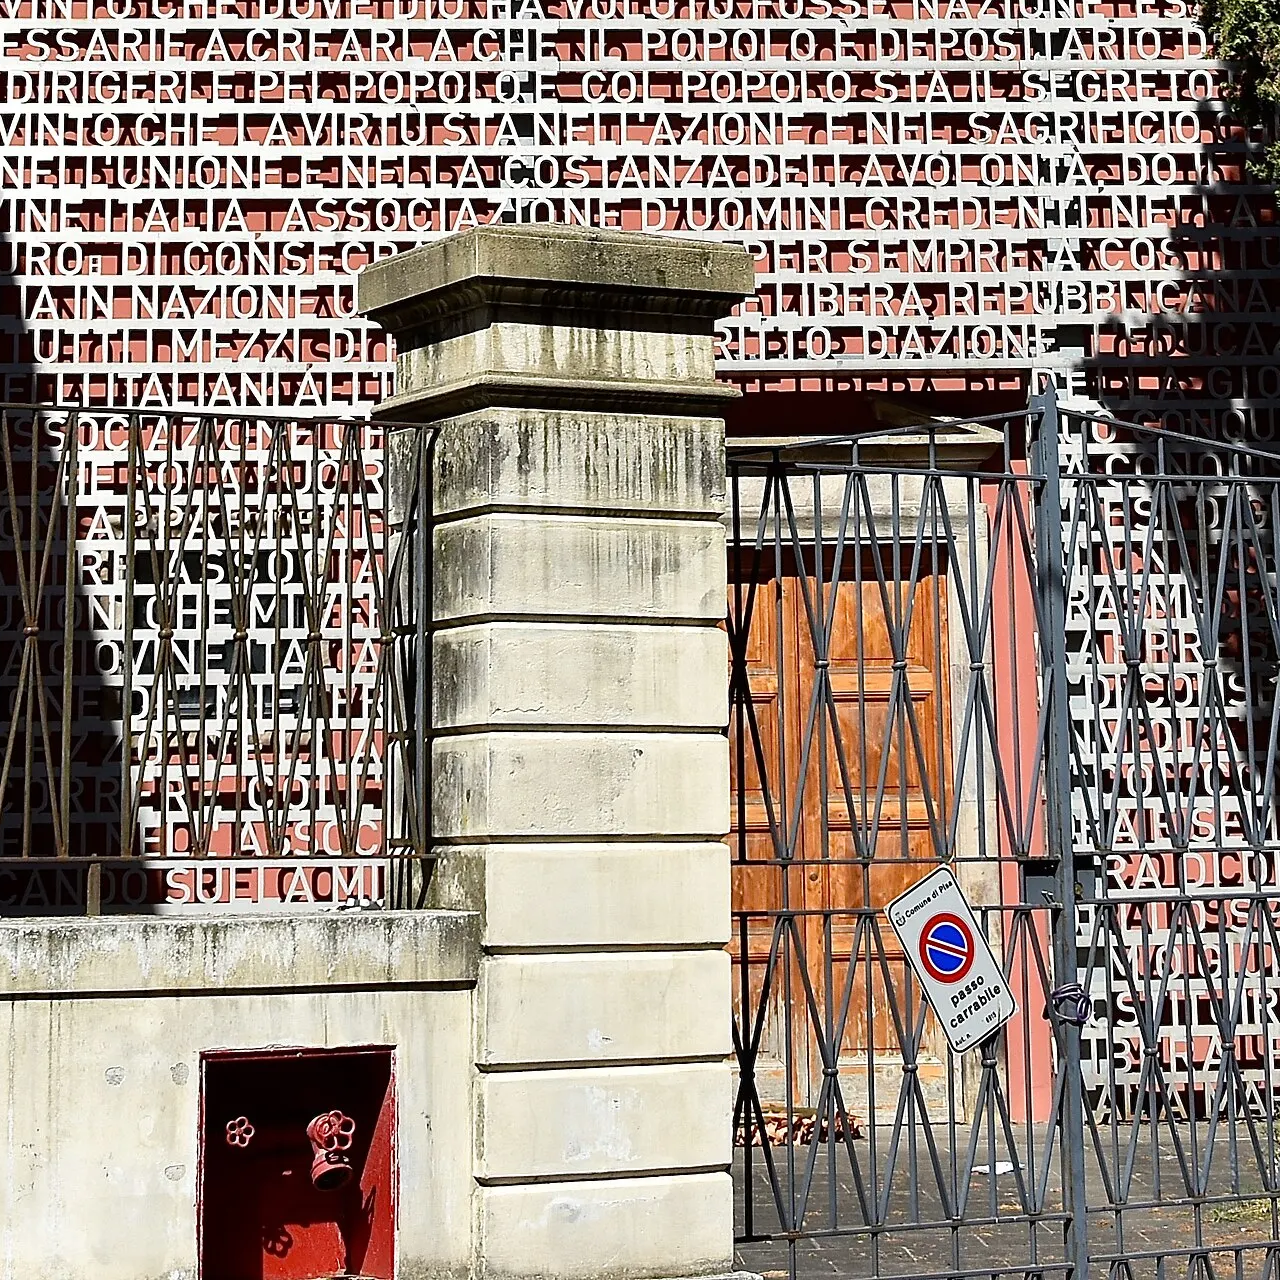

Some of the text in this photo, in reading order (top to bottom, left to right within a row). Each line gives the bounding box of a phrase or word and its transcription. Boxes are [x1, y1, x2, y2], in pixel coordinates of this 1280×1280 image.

[247, 28, 457, 62] CREARLA
[473, 27, 558, 62] CHE
[645, 27, 816, 62] POPOLO
[877, 27, 1161, 62] DEPOSITARIO
[8, 70, 236, 104] DIRIGERLE
[255, 70, 333, 104] PEL
[351, 69, 520, 104] POPOLO
[581, 69, 669, 103] COL
[681, 69, 851, 103] POPOLO
[875, 69, 950, 103] STA
[1024, 69, 1214, 103] SEGRETO
[135, 112, 221, 147] CHE
[239, 112, 290, 146] LA
[443, 111, 522, 146] STA
[868, 111, 946, 145] NEL
[343, 154, 486, 189] NELLA
[504, 153, 735, 189] COSTANZA
[750, 153, 890, 188] DELLA
[1123, 153, 1176, 188] DO
[282, 197, 620, 232] ASSOCIAZIONE
[866, 196, 1086, 230] CREDENTI
[849, 238, 1030, 273] SEMPRE
[132, 283, 320, 319] NAZIONE
[174, 327, 302, 363] MEZZI
[905, 896, 932, 918] Comune
[938, 880, 953, 894] Pisa
[950, 975, 985, 1008] passo
[950, 984, 1001, 1028] carrabile
